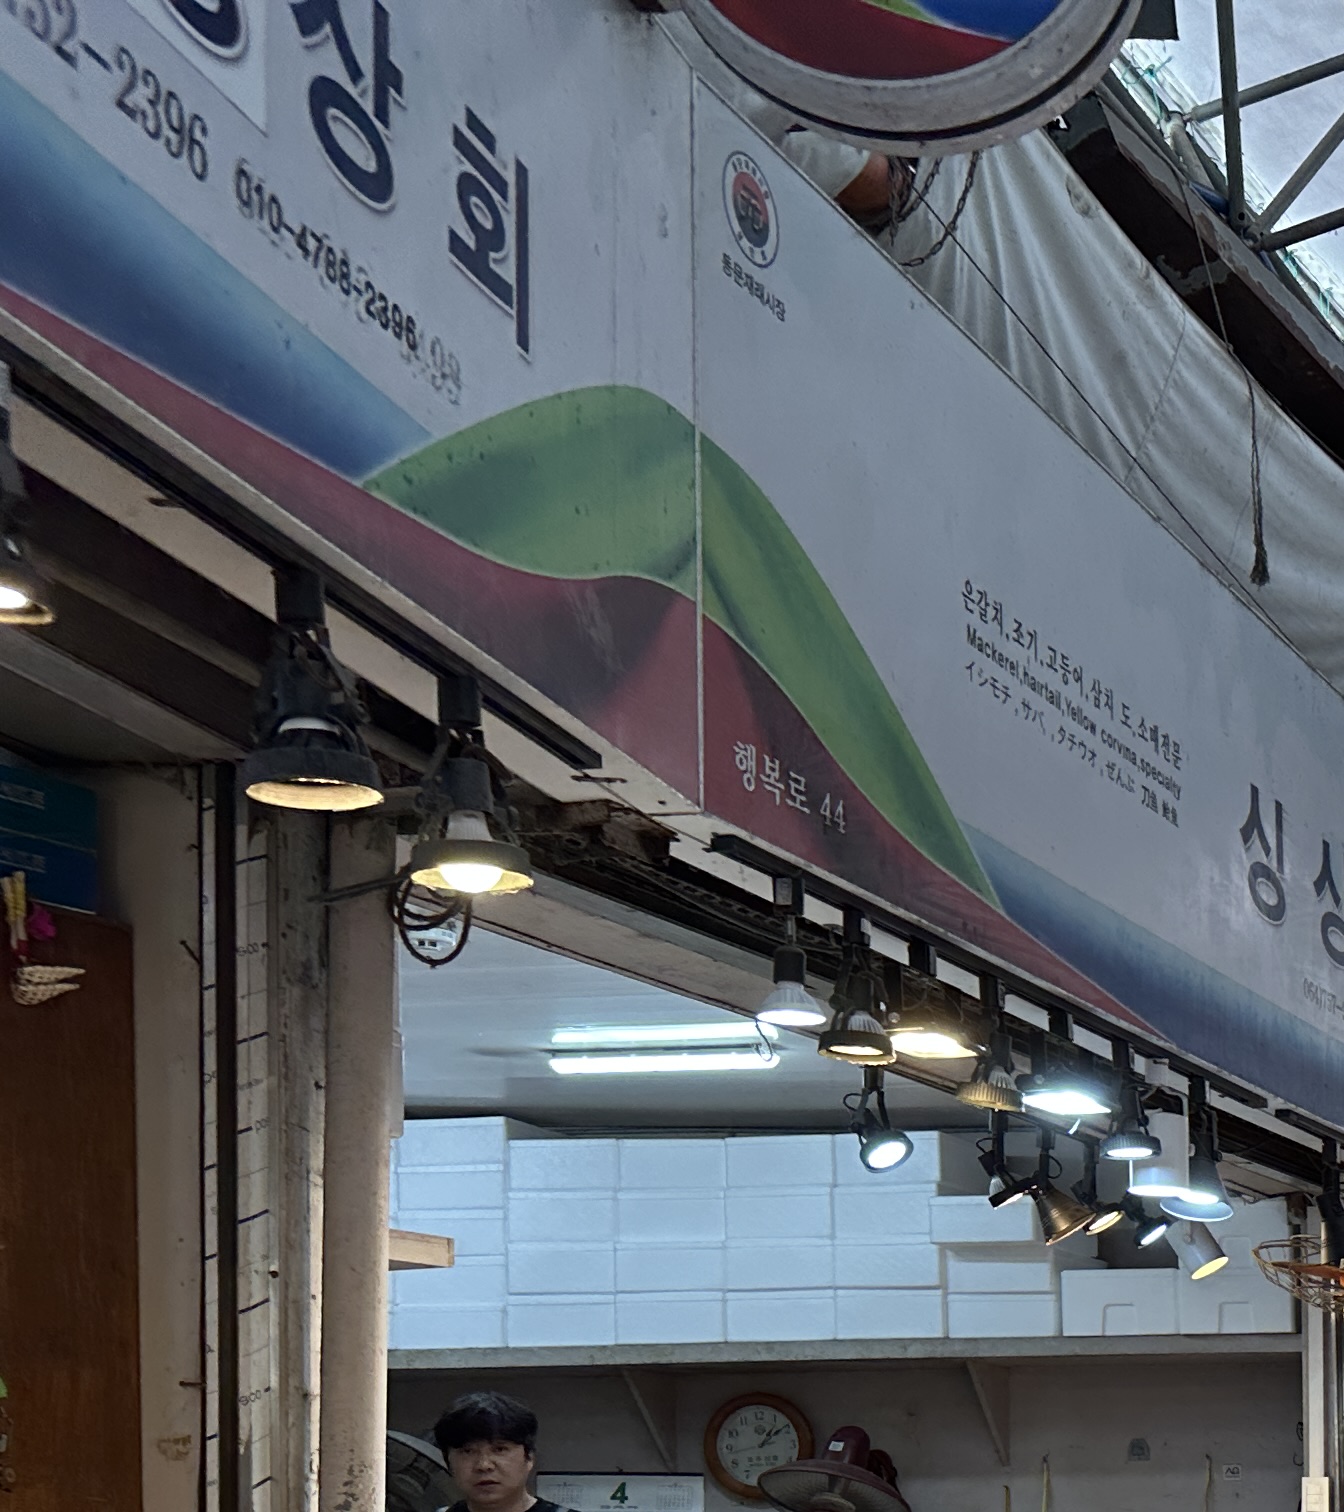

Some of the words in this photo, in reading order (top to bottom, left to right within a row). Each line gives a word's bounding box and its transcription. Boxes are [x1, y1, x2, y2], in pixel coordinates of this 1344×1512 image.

[733, 741, 811, 814] 행복로
[820, 793, 846, 834] 44
[610, 1481, 629, 1504] 4
